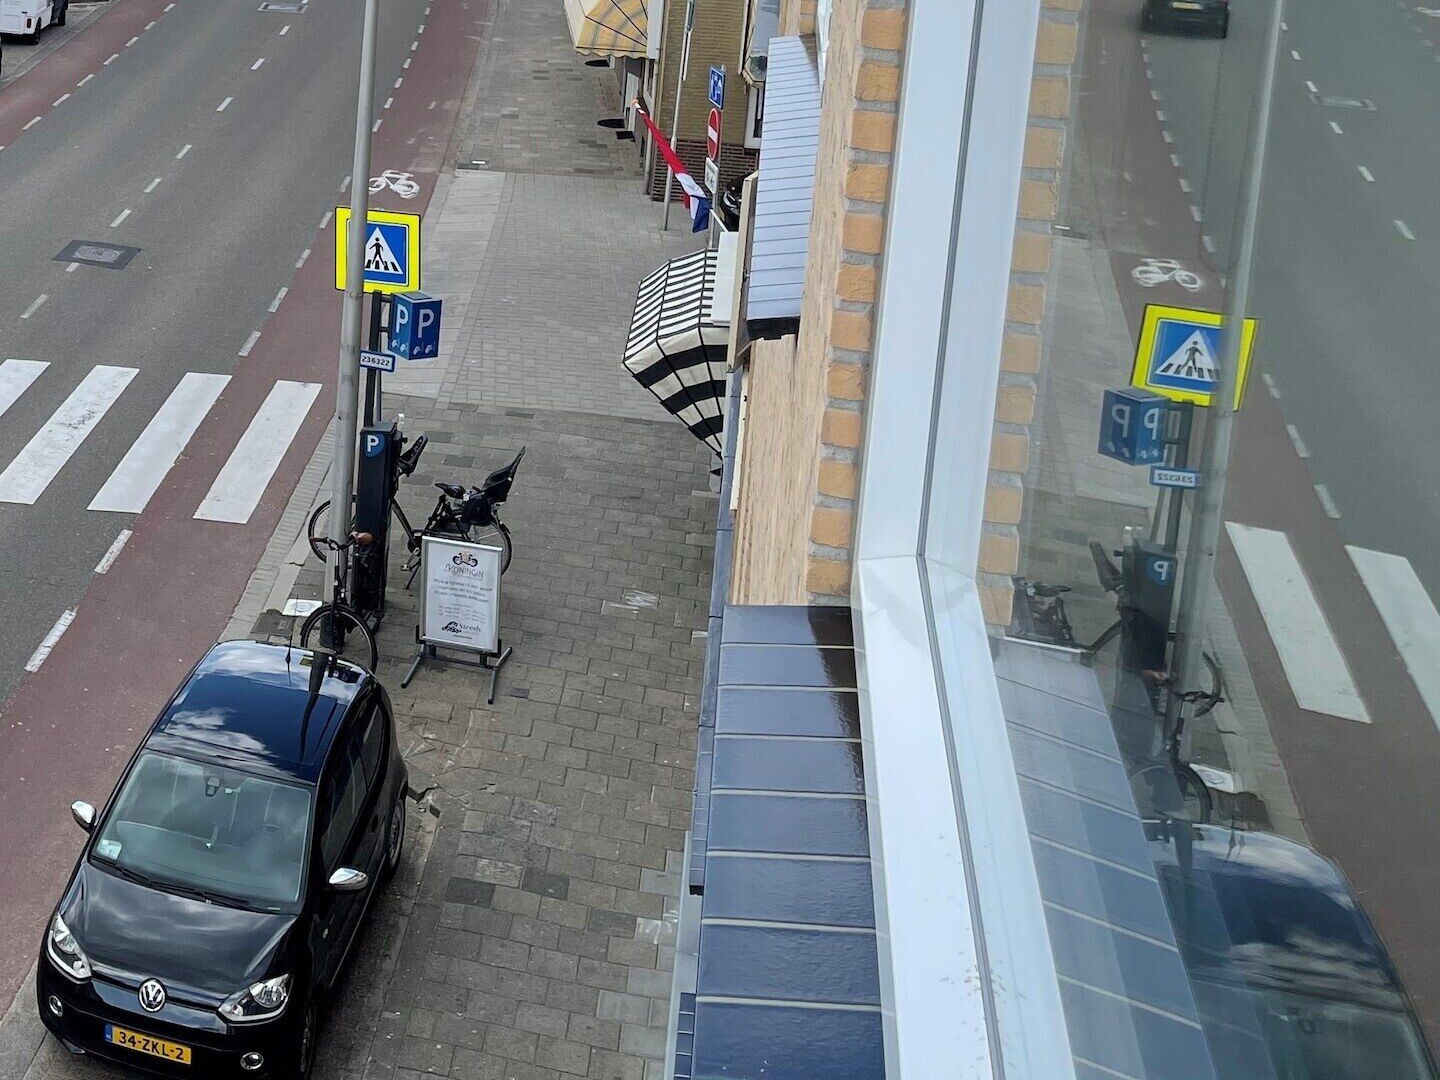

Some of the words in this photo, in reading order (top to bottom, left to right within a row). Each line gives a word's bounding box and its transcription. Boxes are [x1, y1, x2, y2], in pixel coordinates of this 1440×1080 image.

[395, 303, 409, 333] P
[417, 308, 435, 338] P
[361, 355, 390, 367] 236322
[367, 434, 379, 452] P
[118, 1031, 184, 1061] 34-ZKL-2
